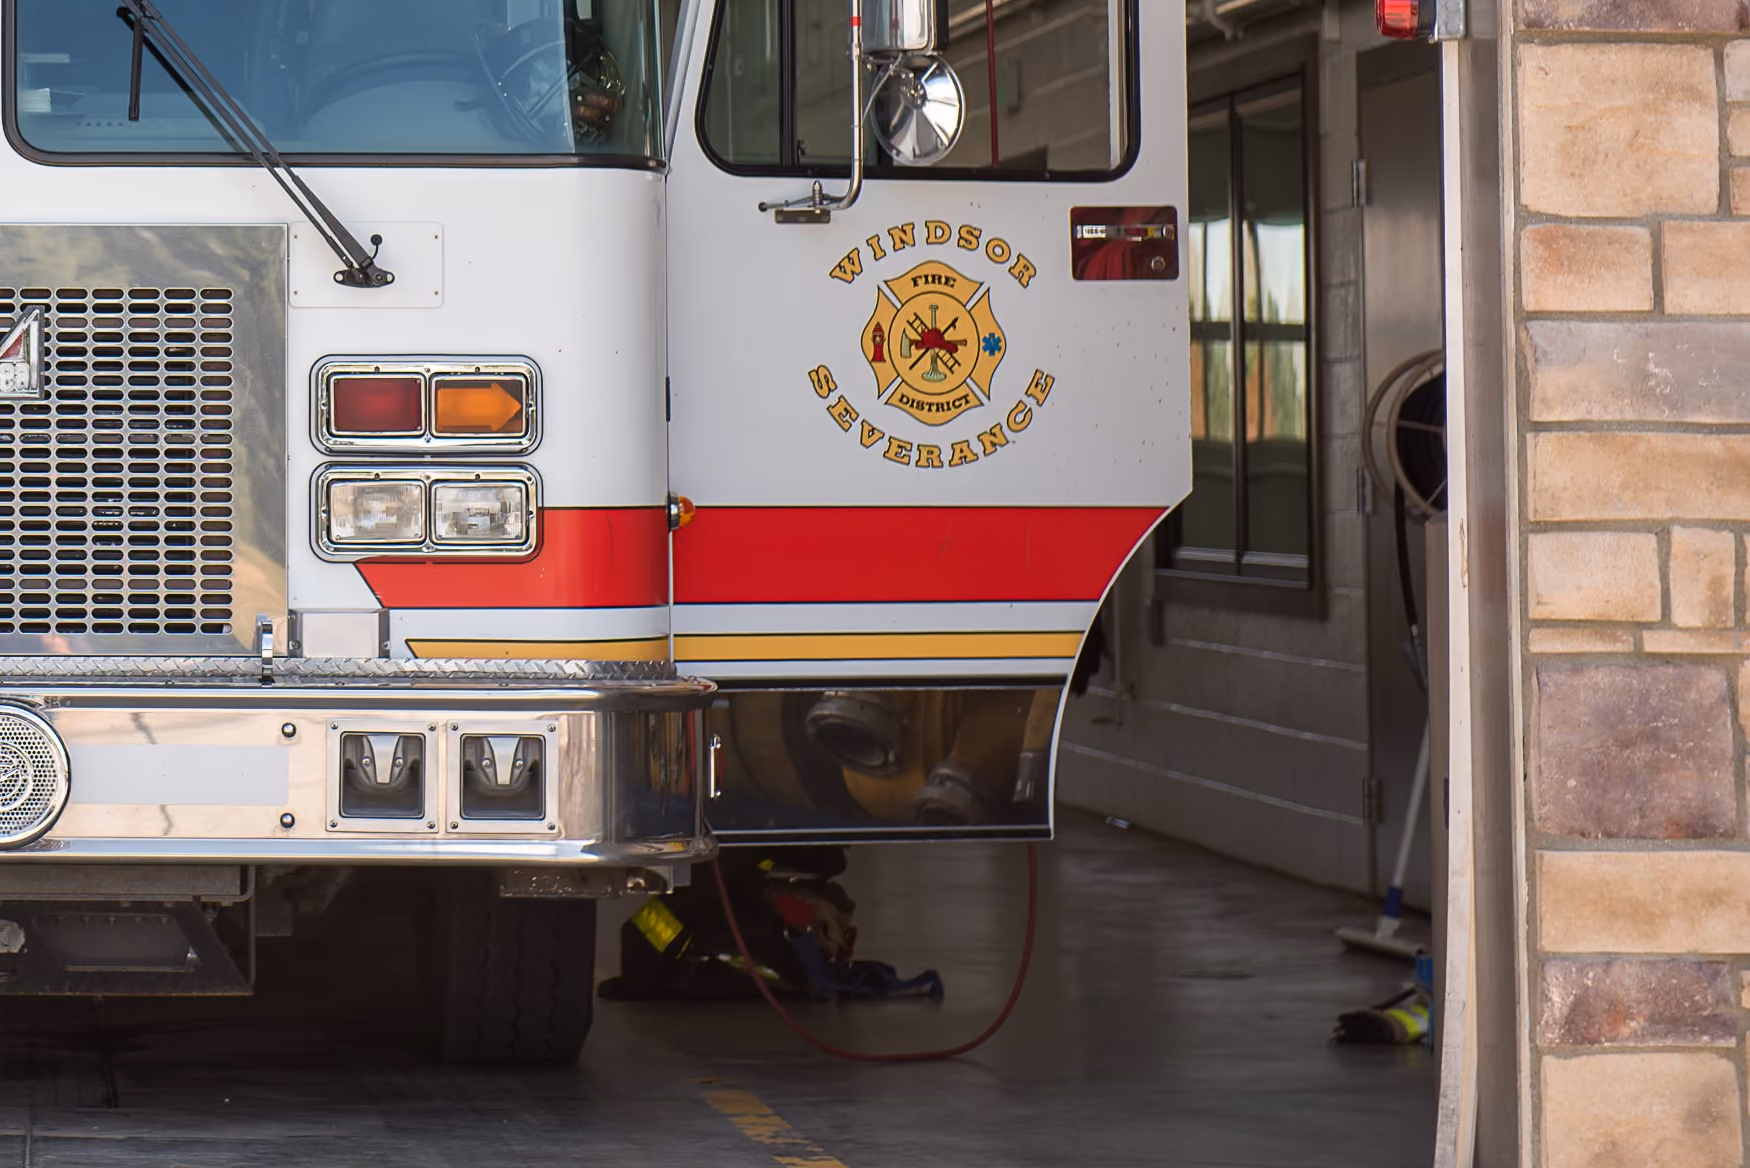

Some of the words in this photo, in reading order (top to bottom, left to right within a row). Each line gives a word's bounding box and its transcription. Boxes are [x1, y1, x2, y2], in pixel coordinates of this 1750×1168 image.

[829, 219, 1037, 289] WINDSOR
[911, 273, 957, 289] FIRE
[808, 364, 1056, 468] SEVERANCE
[898, 393, 971, 413] DISTRICT
